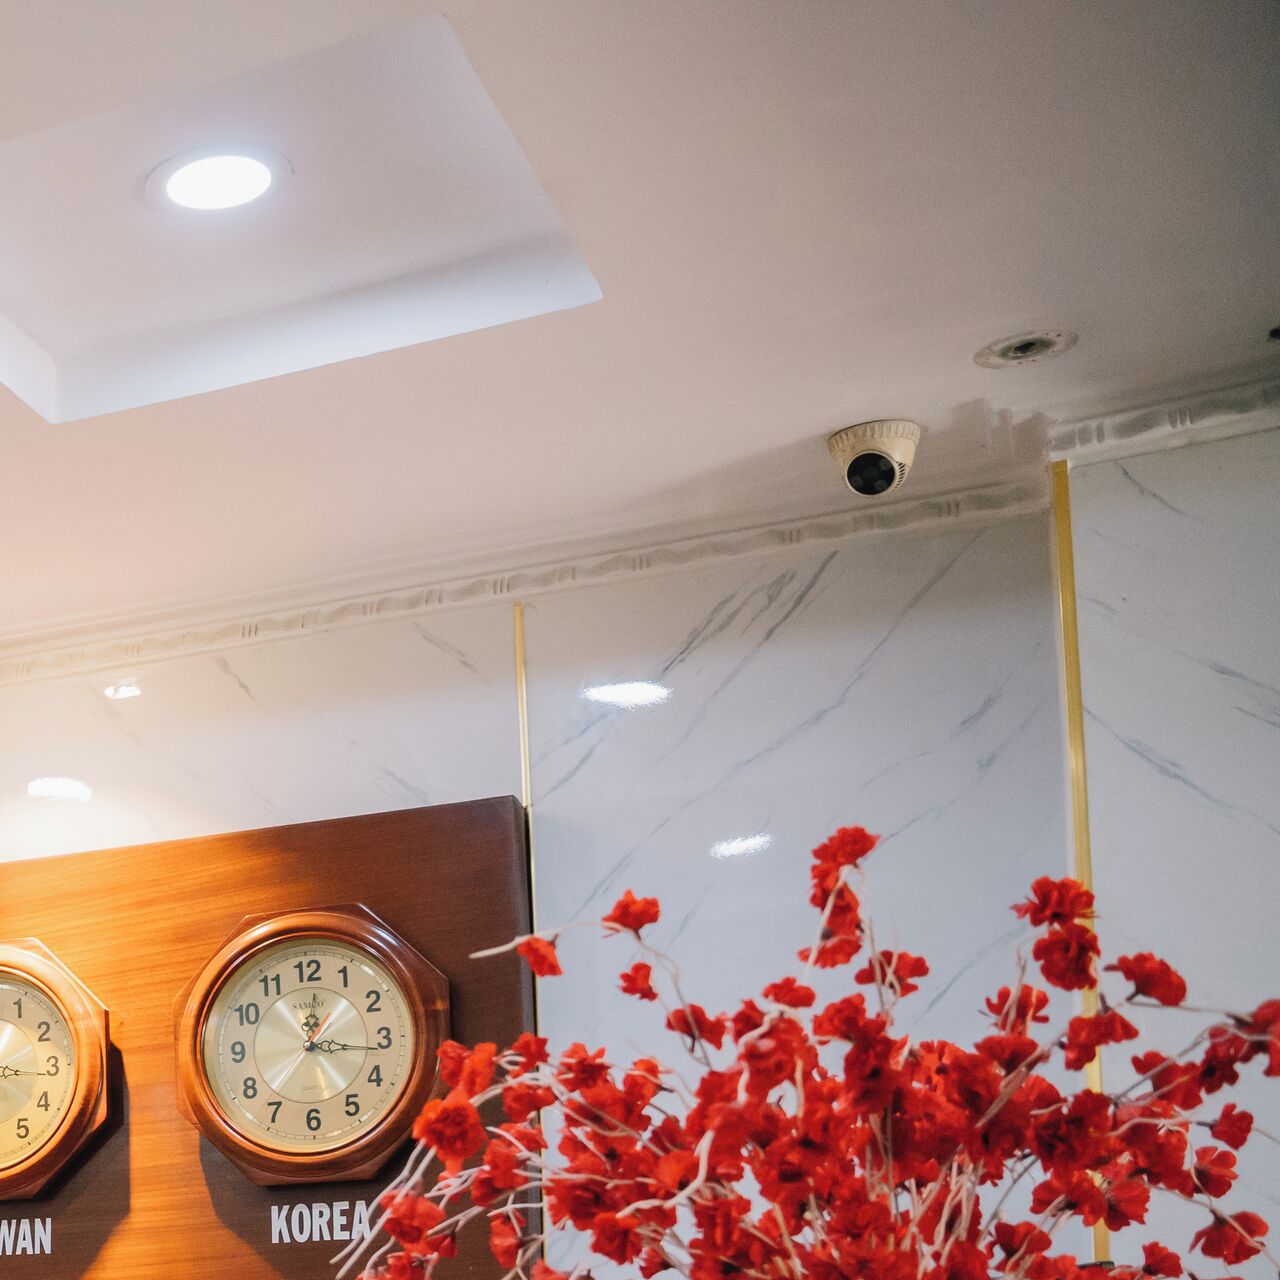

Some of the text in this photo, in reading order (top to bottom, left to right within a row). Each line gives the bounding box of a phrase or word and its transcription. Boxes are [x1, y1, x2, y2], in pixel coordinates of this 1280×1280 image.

[294, 959, 321, 983] 12
[338, 966, 348, 988] 1
[259, 974, 281, 997] 11
[13, 998, 22, 1018] 1
[366, 990, 381, 1013] 2
[234, 1003, 259, 1026] 10
[38, 1021, 50, 1042] 2
[377, 1027, 392, 1049] 3
[231, 1041, 246, 1064] 9
[46, 1056, 59, 1076] 3
[368, 1064, 383, 1087] 4
[243, 1077, 258, 1099] 8
[37, 1091, 50, 1112] 4
[267, 1101, 282, 1123] 7
[345, 1094, 360, 1116] 5
[17, 1118, 29, 1139] 5
[306, 1109, 321, 1131] 6
[271, 1200, 372, 1244] KOREA
